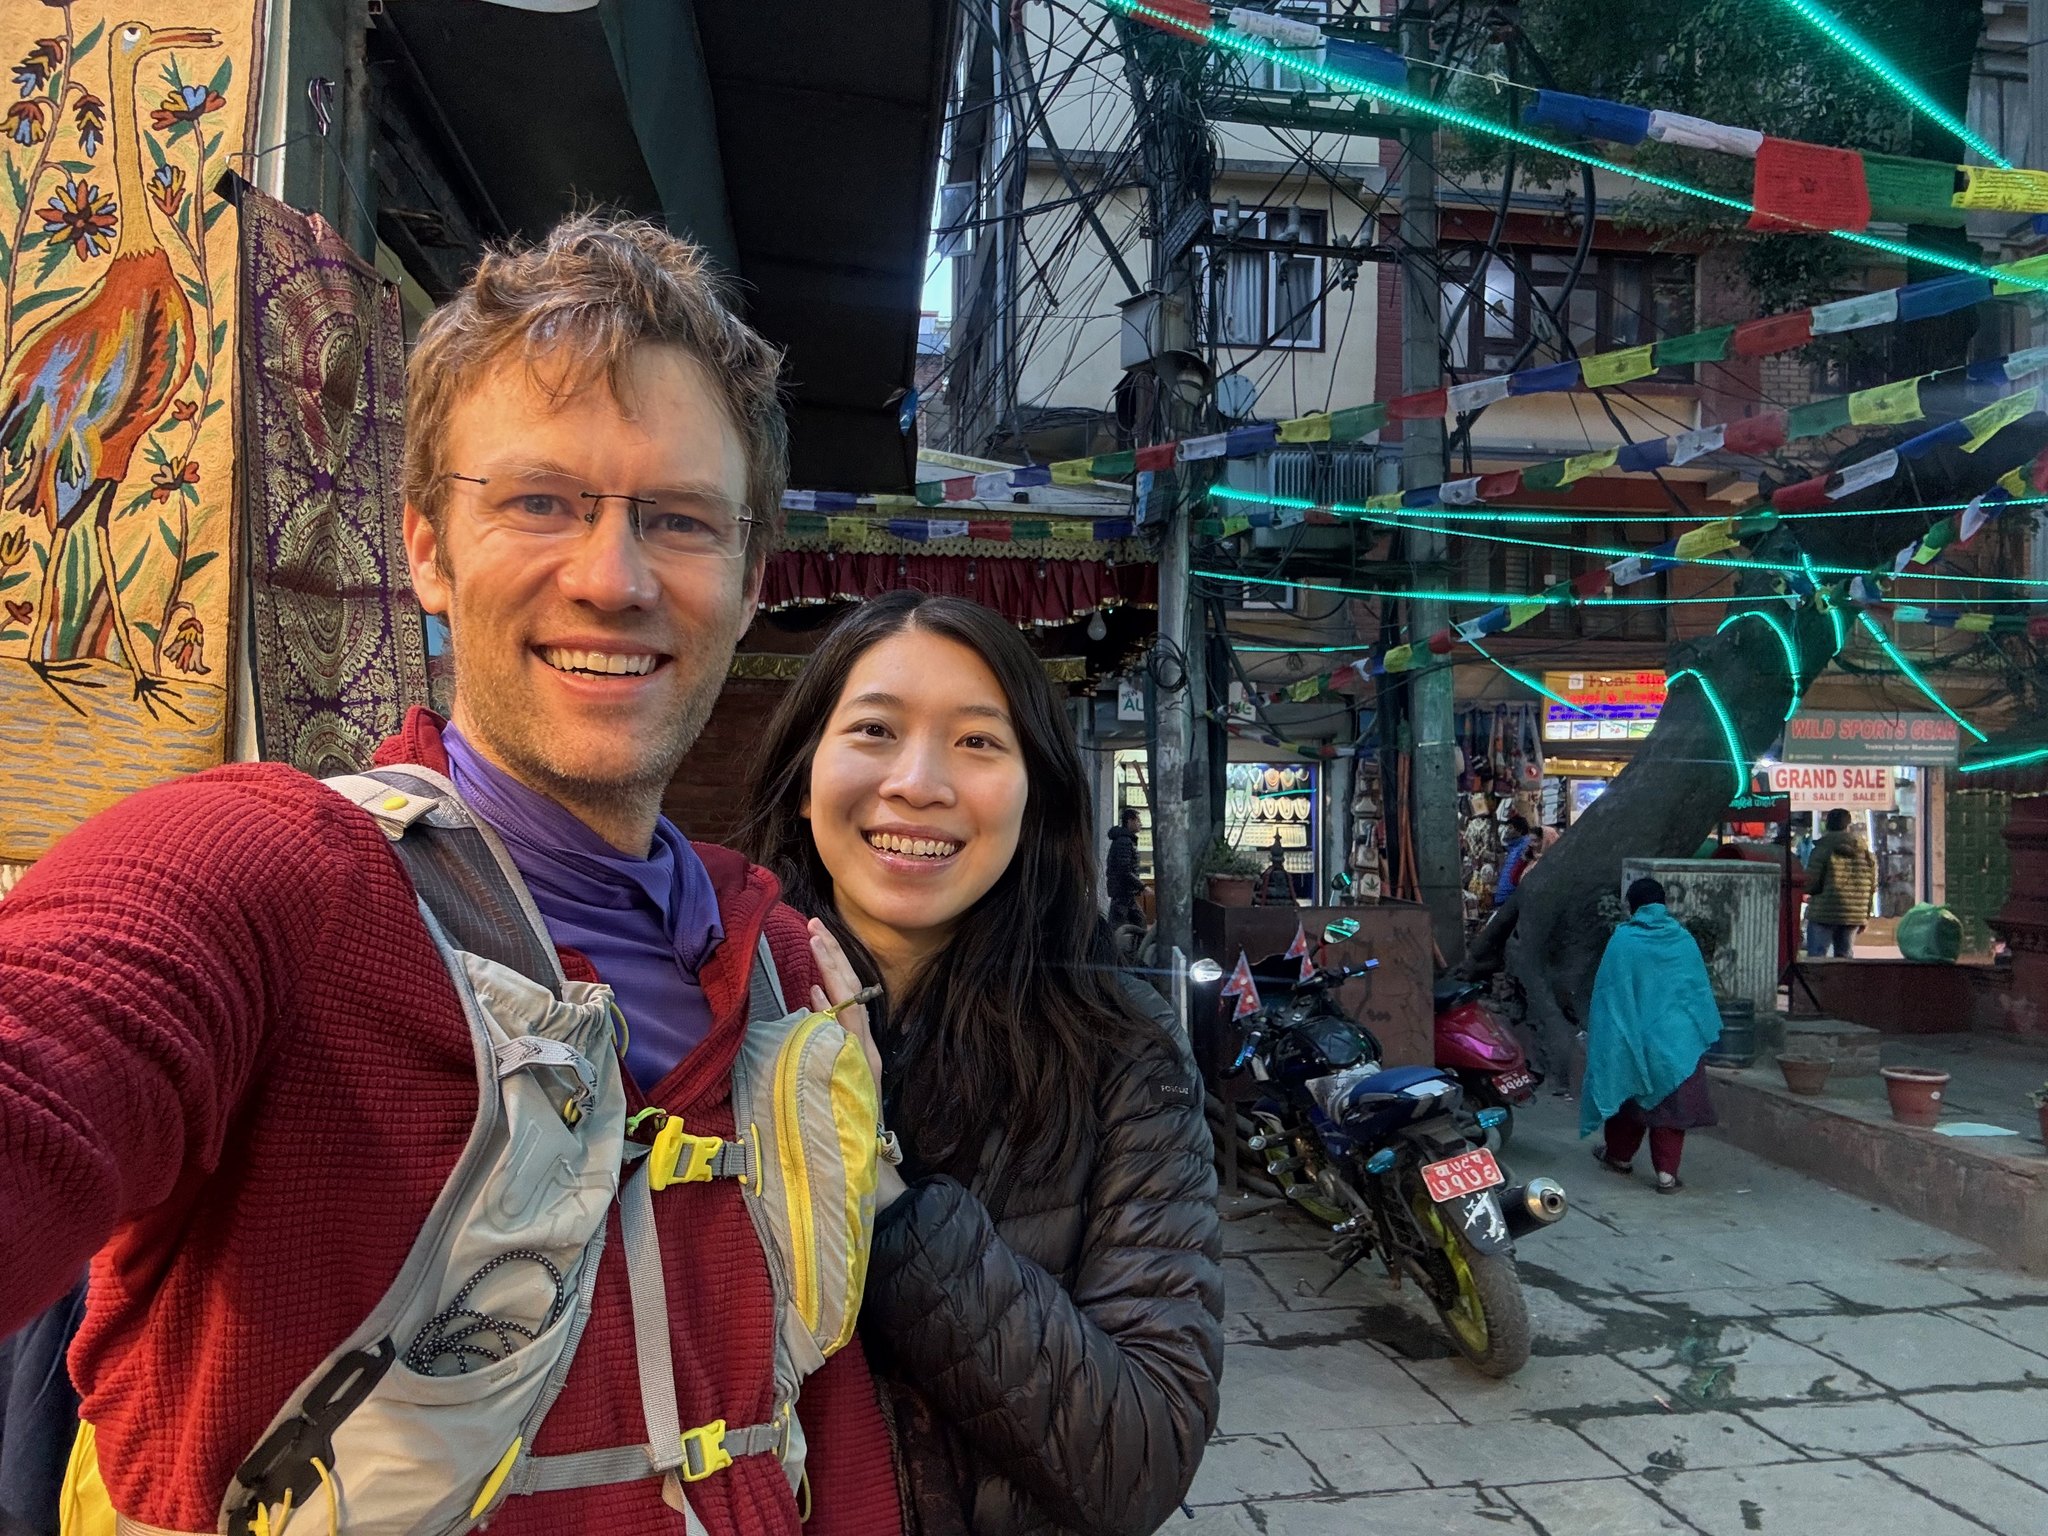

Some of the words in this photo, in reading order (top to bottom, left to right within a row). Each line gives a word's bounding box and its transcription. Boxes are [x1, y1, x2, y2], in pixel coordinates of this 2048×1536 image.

[1791, 718, 1836, 740] WILD
[1839, 719, 1907, 740] SPORTS
[1910, 719, 1957, 741] GEAR
[1775, 768, 1837, 789] GRAND
[1843, 768, 1886, 788] SALE
